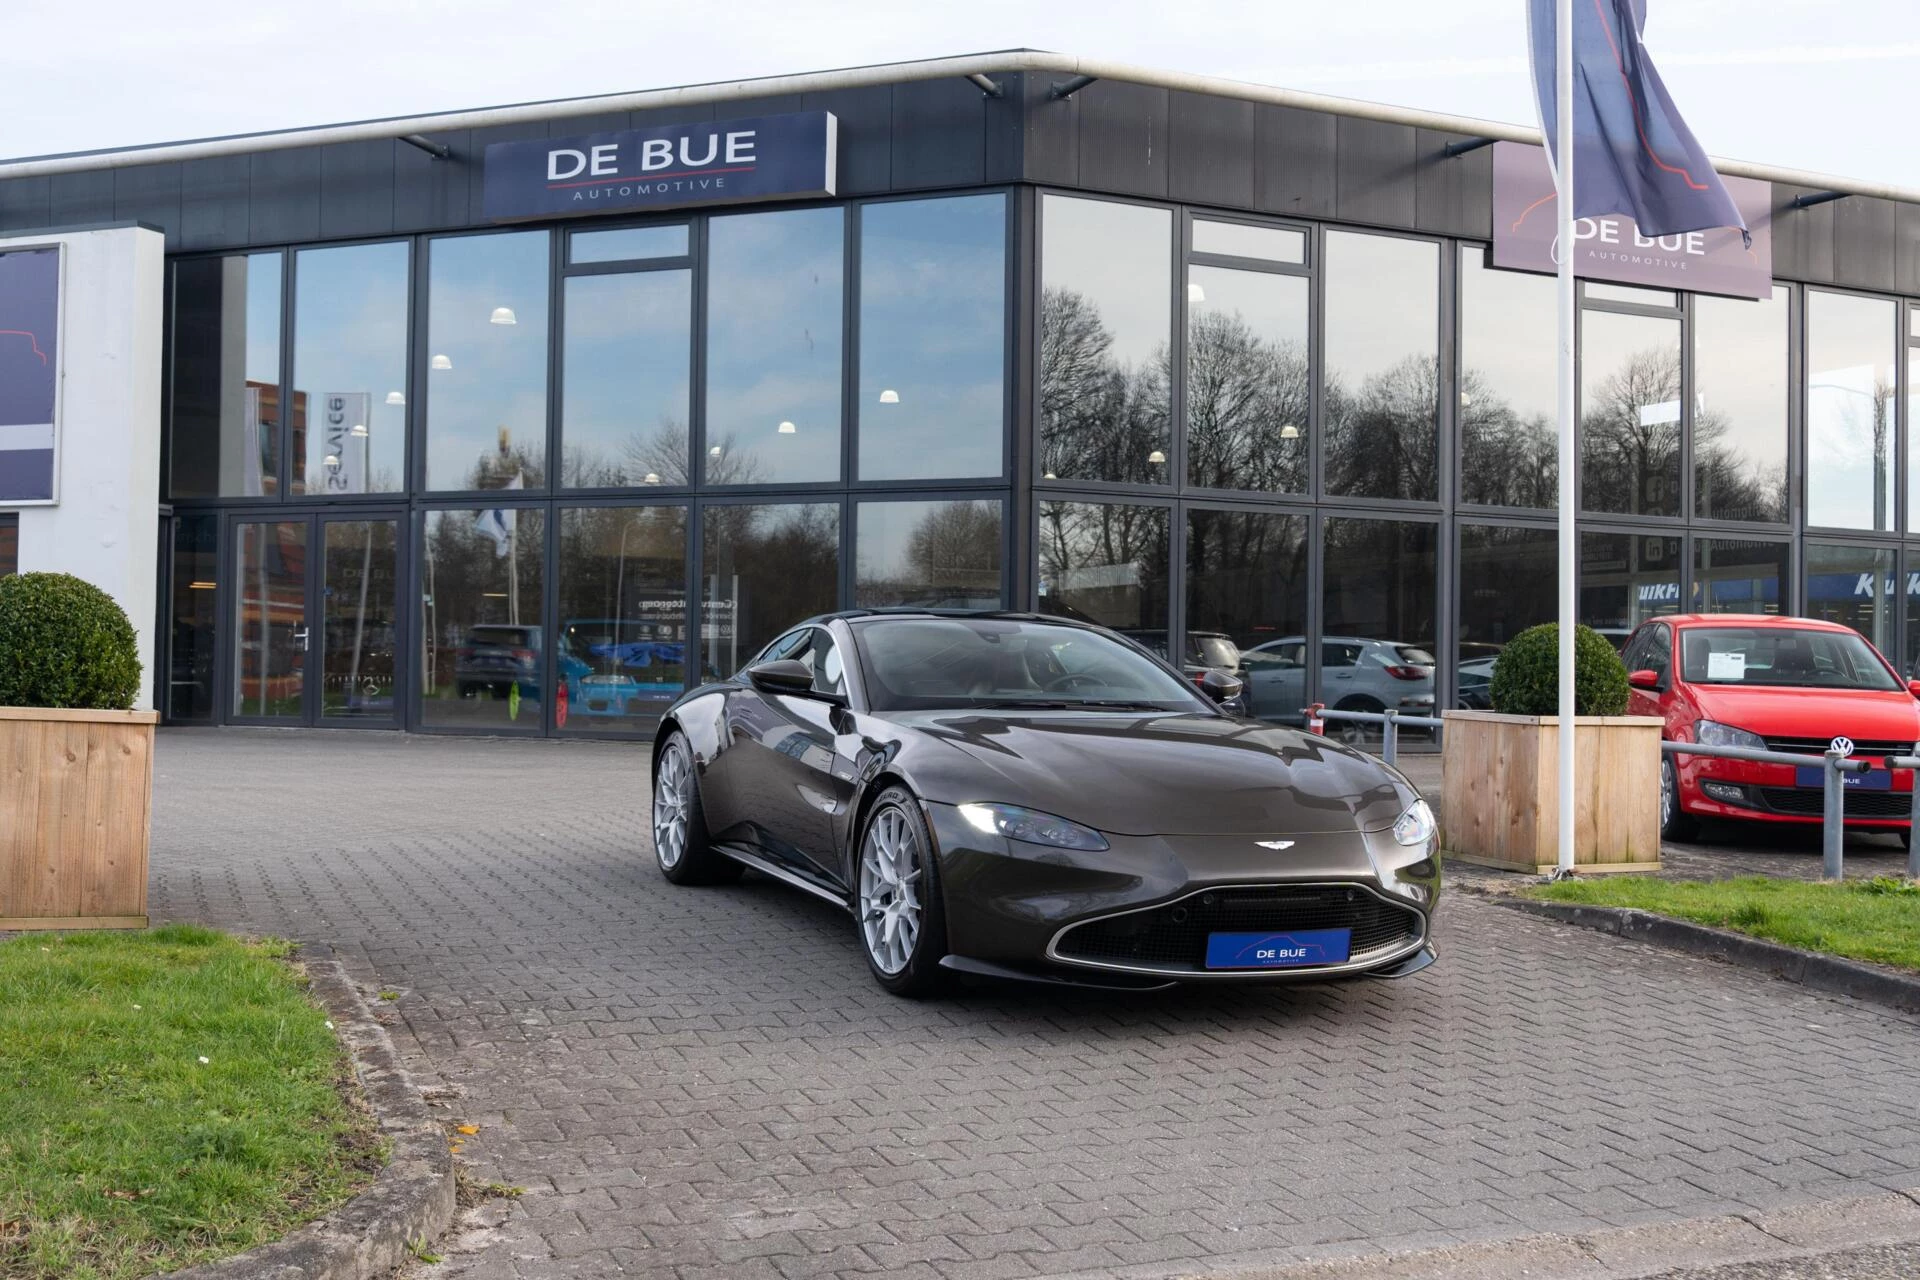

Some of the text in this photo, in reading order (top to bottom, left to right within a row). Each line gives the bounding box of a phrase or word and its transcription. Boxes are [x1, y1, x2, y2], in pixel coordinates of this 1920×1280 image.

[547, 130, 756, 180] DE BUE
[573, 178, 726, 200] AUTOMOTIVE
[1572, 217, 1619, 244] DE
[1589, 250, 1687, 270] AUTOMOTIVE
[1257, 949, 1306, 958] DE BUE
